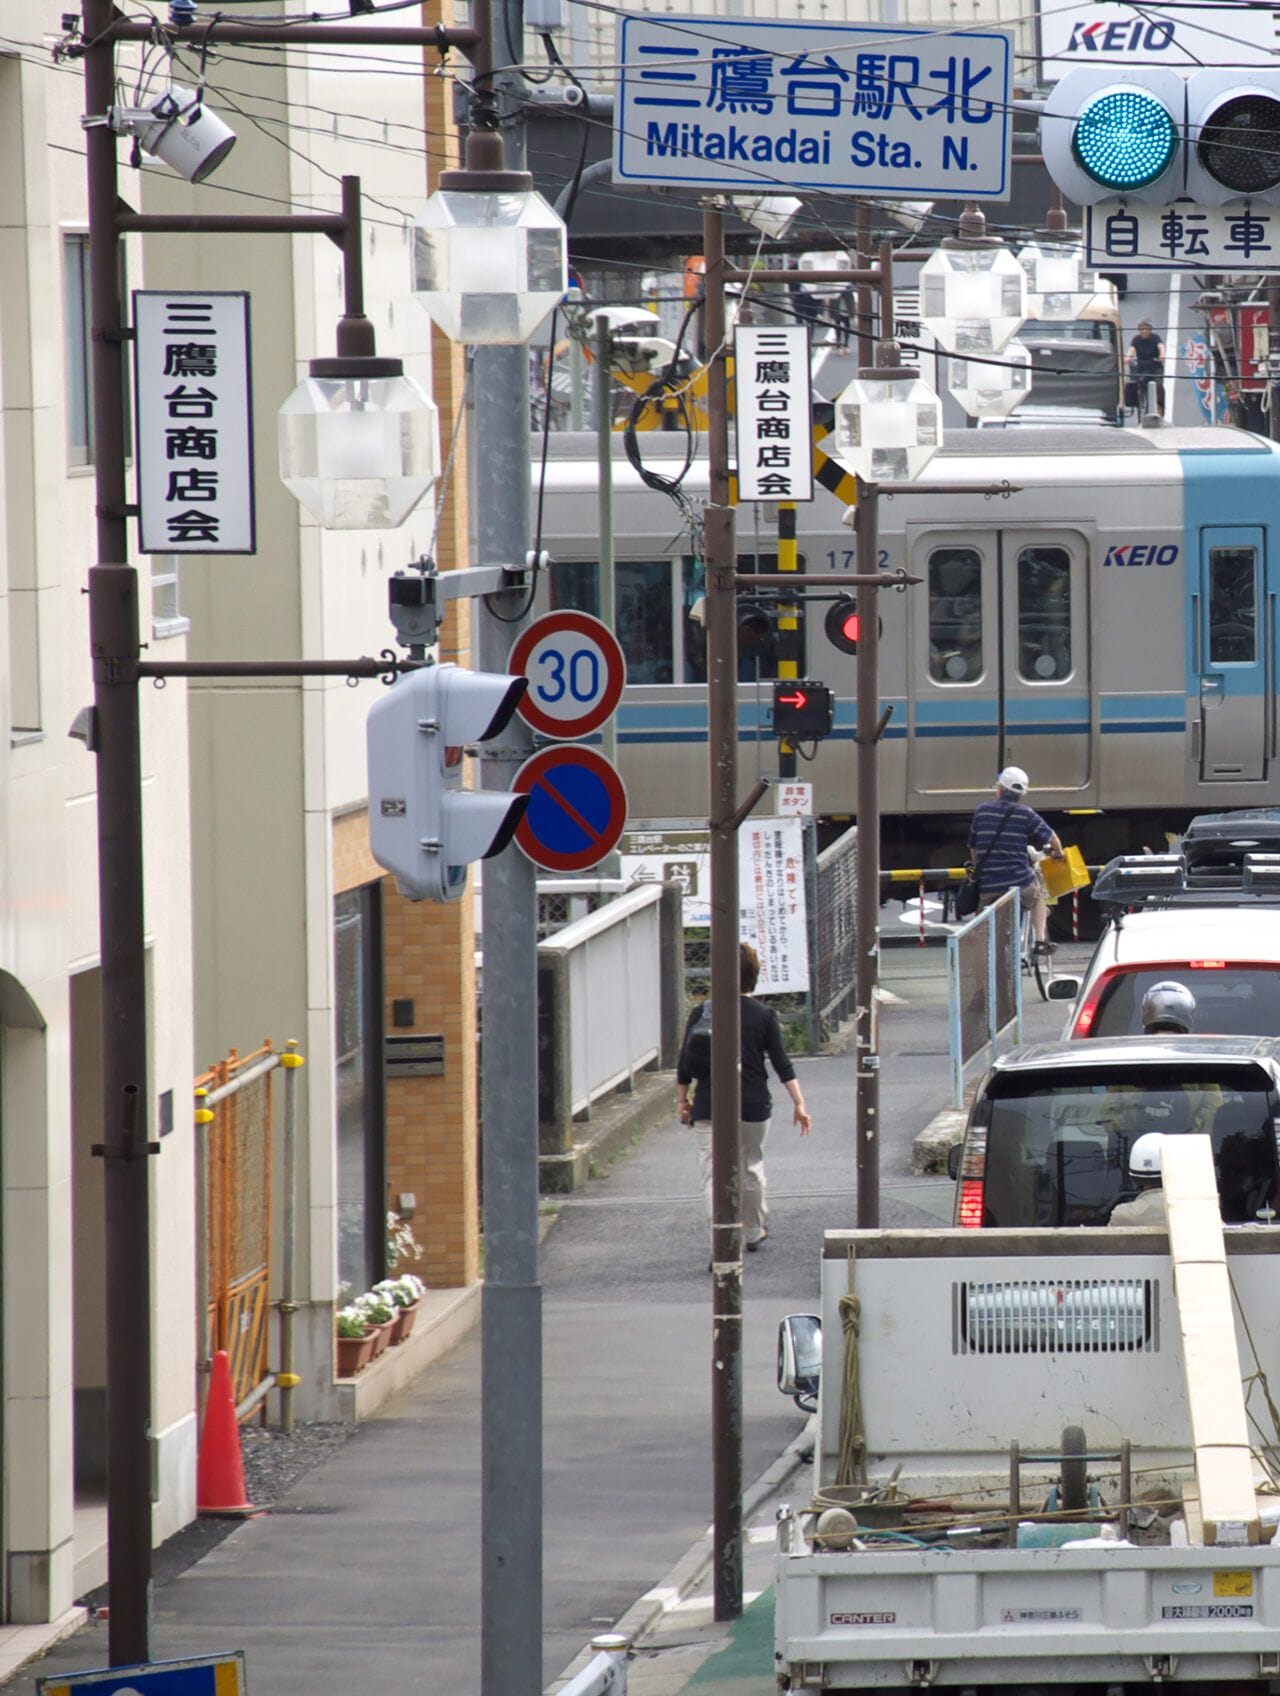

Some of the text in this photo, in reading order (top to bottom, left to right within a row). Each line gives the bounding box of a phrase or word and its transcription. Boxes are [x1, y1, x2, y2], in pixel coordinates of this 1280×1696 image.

[1067, 20, 1176, 52] KEIO
[632, 44, 994, 125] 三鷹台駅北
[646, 121, 979, 172] Mitakadai Sta. N.
[162, 302, 220, 544] 三鷹台商店会
[754, 333, 793, 497] 三鷹台商店会
[827, 550, 890, 569] 172
[1103, 544, 1179, 567] KEIO
[536, 648, 599, 703] 30
[782, 798, 808, 806] ボタン
[785, 787, 805, 795] 非常
[831, 1613, 894, 1624] CANTER
